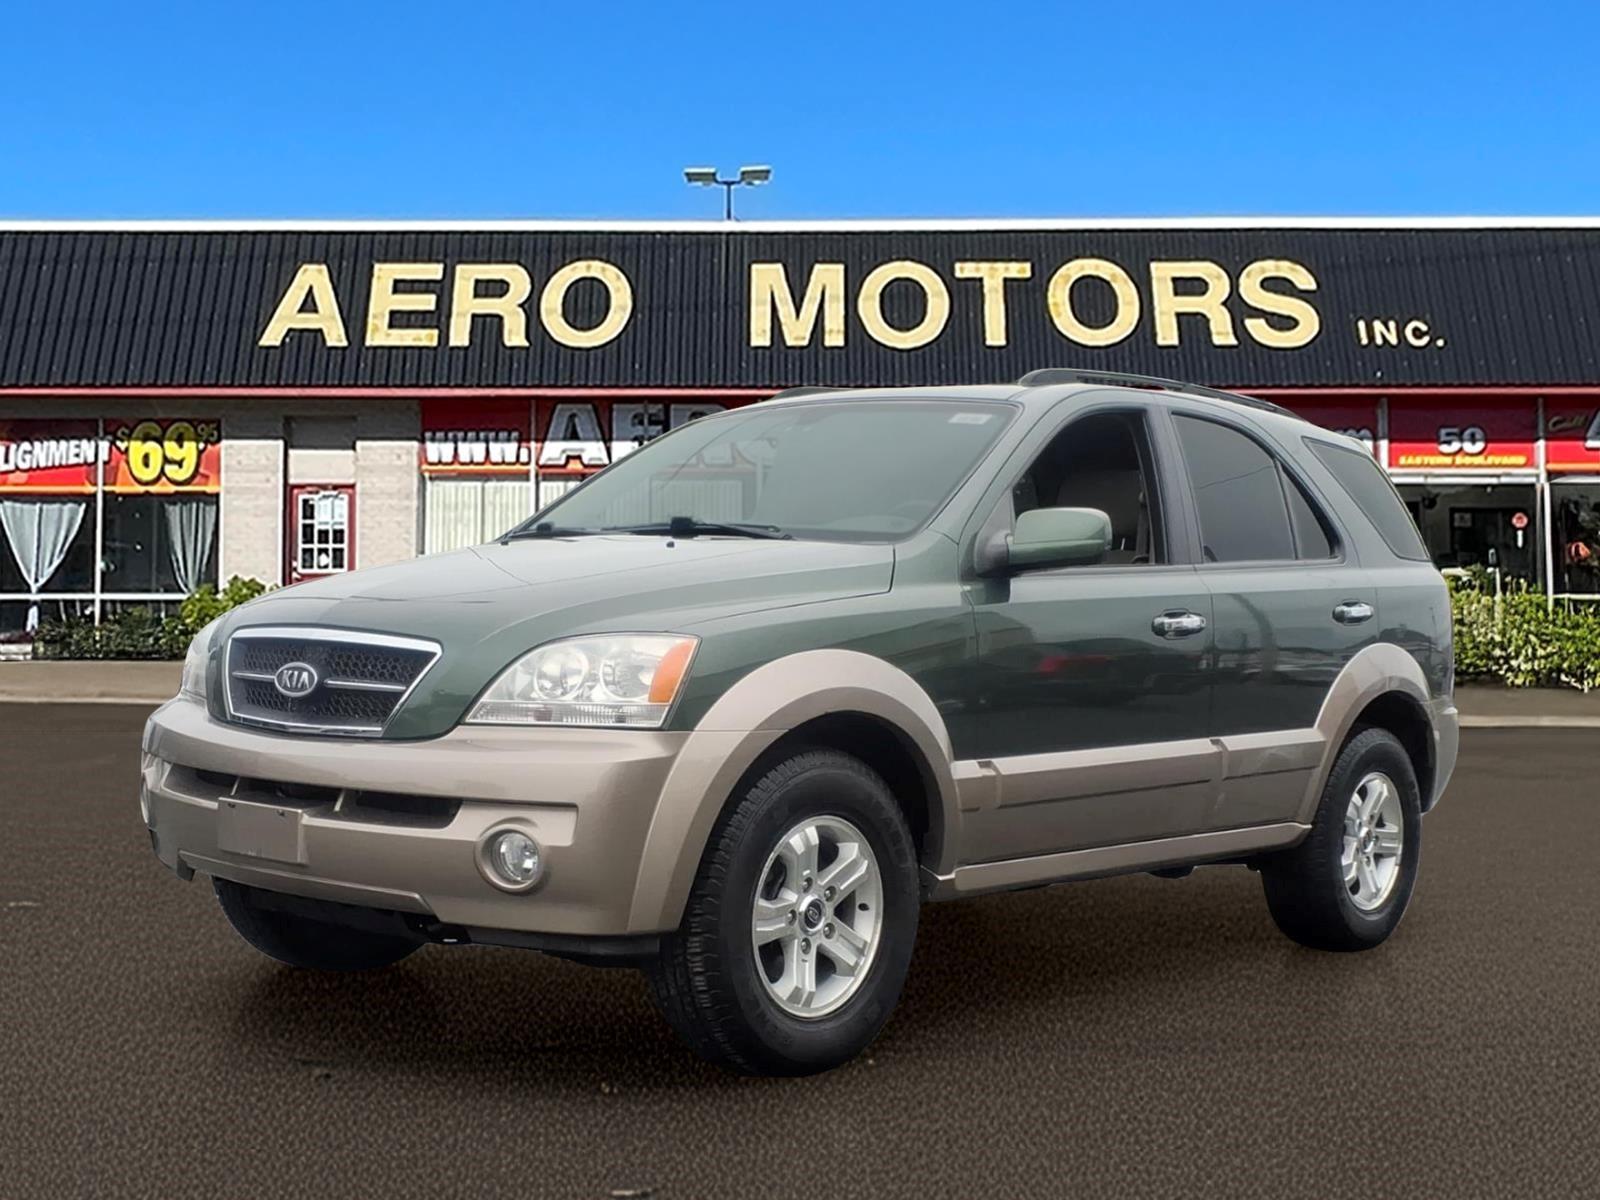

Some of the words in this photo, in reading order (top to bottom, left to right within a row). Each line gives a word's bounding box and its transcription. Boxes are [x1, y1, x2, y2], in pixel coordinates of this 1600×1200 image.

[258, 259, 633, 349] AERO
[750, 258, 1320, 350] MOTORS
[1357, 318, 1447, 348] INC.
[1437, 426, 1486, 454] 50
[281, 670, 310, 689] KIA
